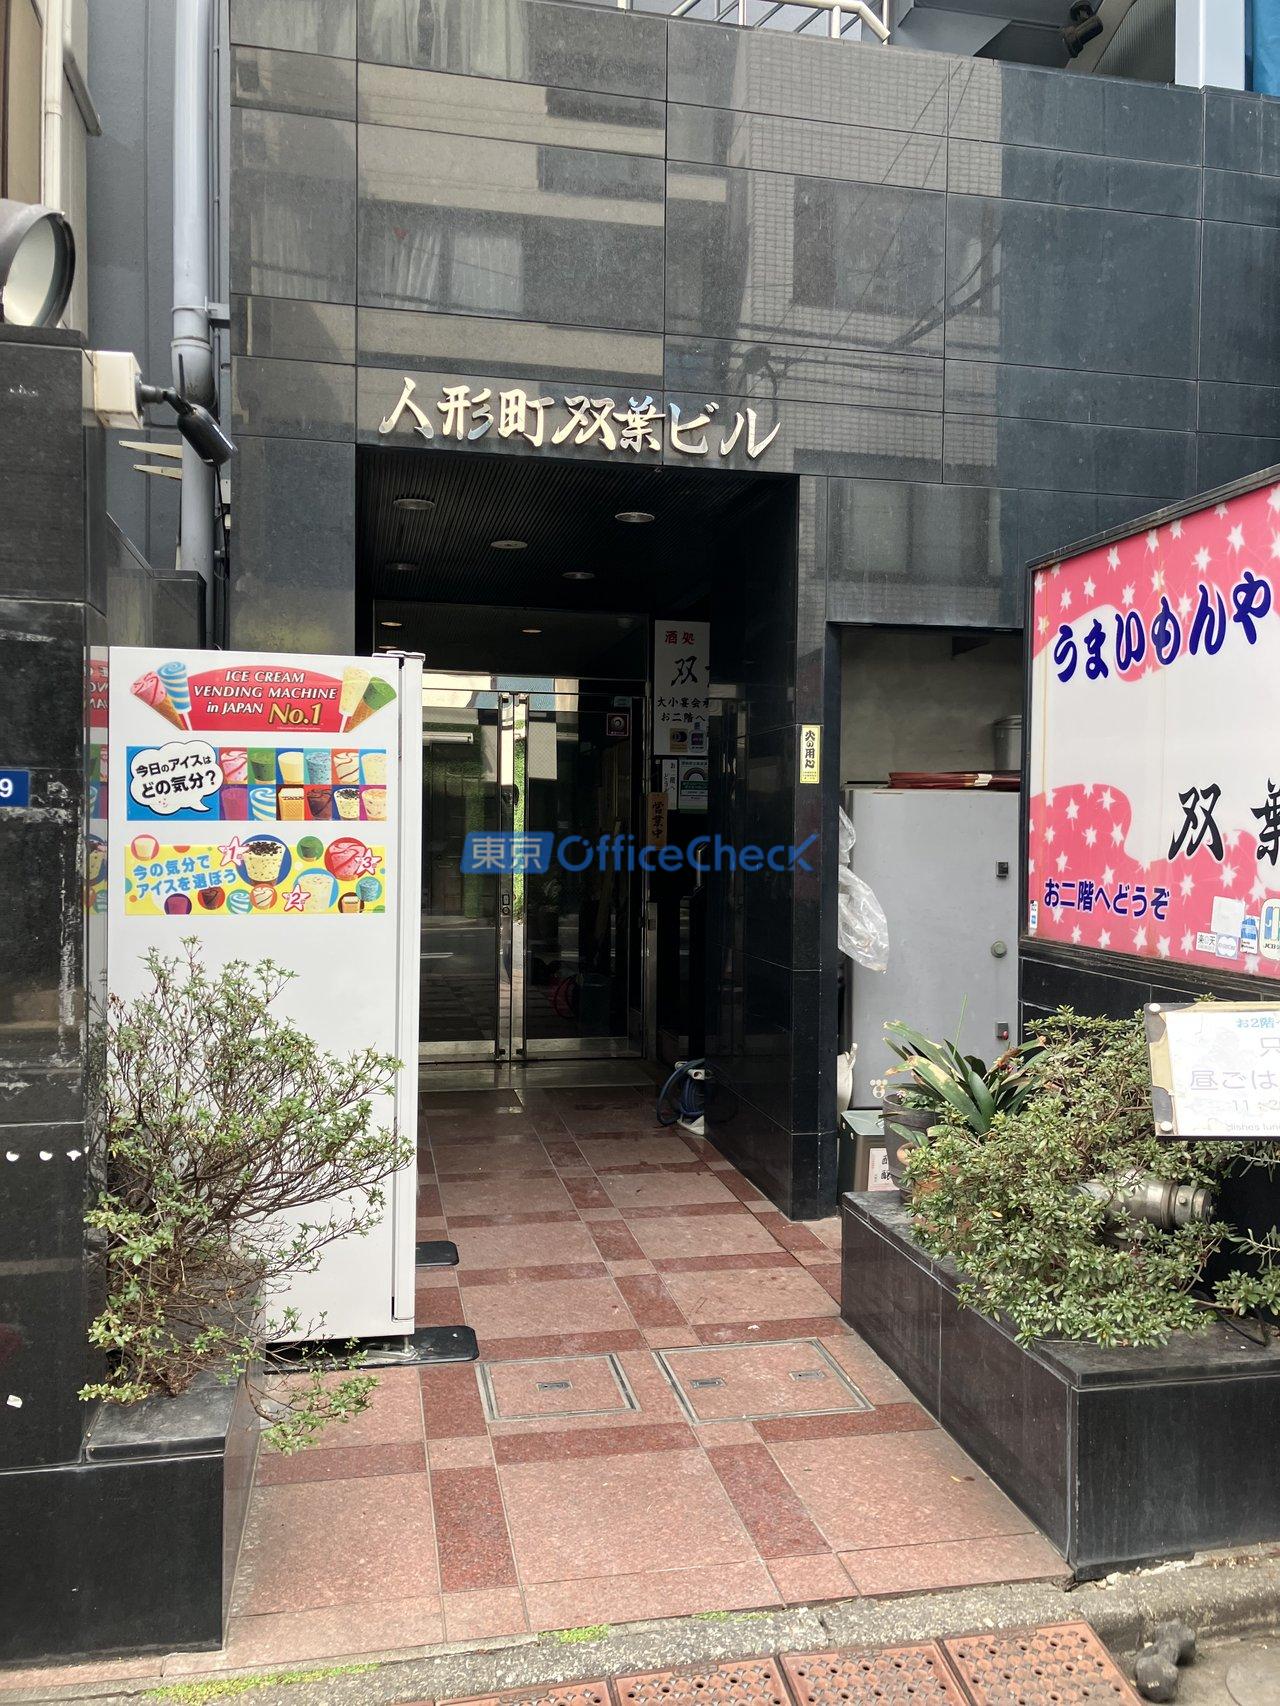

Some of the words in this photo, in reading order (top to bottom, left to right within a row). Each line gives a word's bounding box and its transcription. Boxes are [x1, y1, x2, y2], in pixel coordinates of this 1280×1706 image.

[378, 377, 780, 458] 人形町双葉ビル
[664, 630, 696, 645] 酒処
[1054, 571, 1272, 682] うまいもんや
[225, 671, 250, 682] ICE
[254, 671, 305, 683] CREAM
[194, 685, 262, 698] VENDING
[268, 687, 337, 699] MACHINE
[206, 702, 219, 713] in
[221, 702, 264, 715] JAPAN
[268, 702, 322, 725] No.1
[804, 730, 816, 769] 火の用心
[136, 754, 212, 778] 今日のアイスは
[141, 770, 216, 798] どの気分？
[652, 801, 664, 838] 営業中
[133, 855, 210, 880] 今の気分で
[136, 869, 237, 898] アイスを選ぼう
[1044, 878, 1170, 920] お二階へどうぞ
